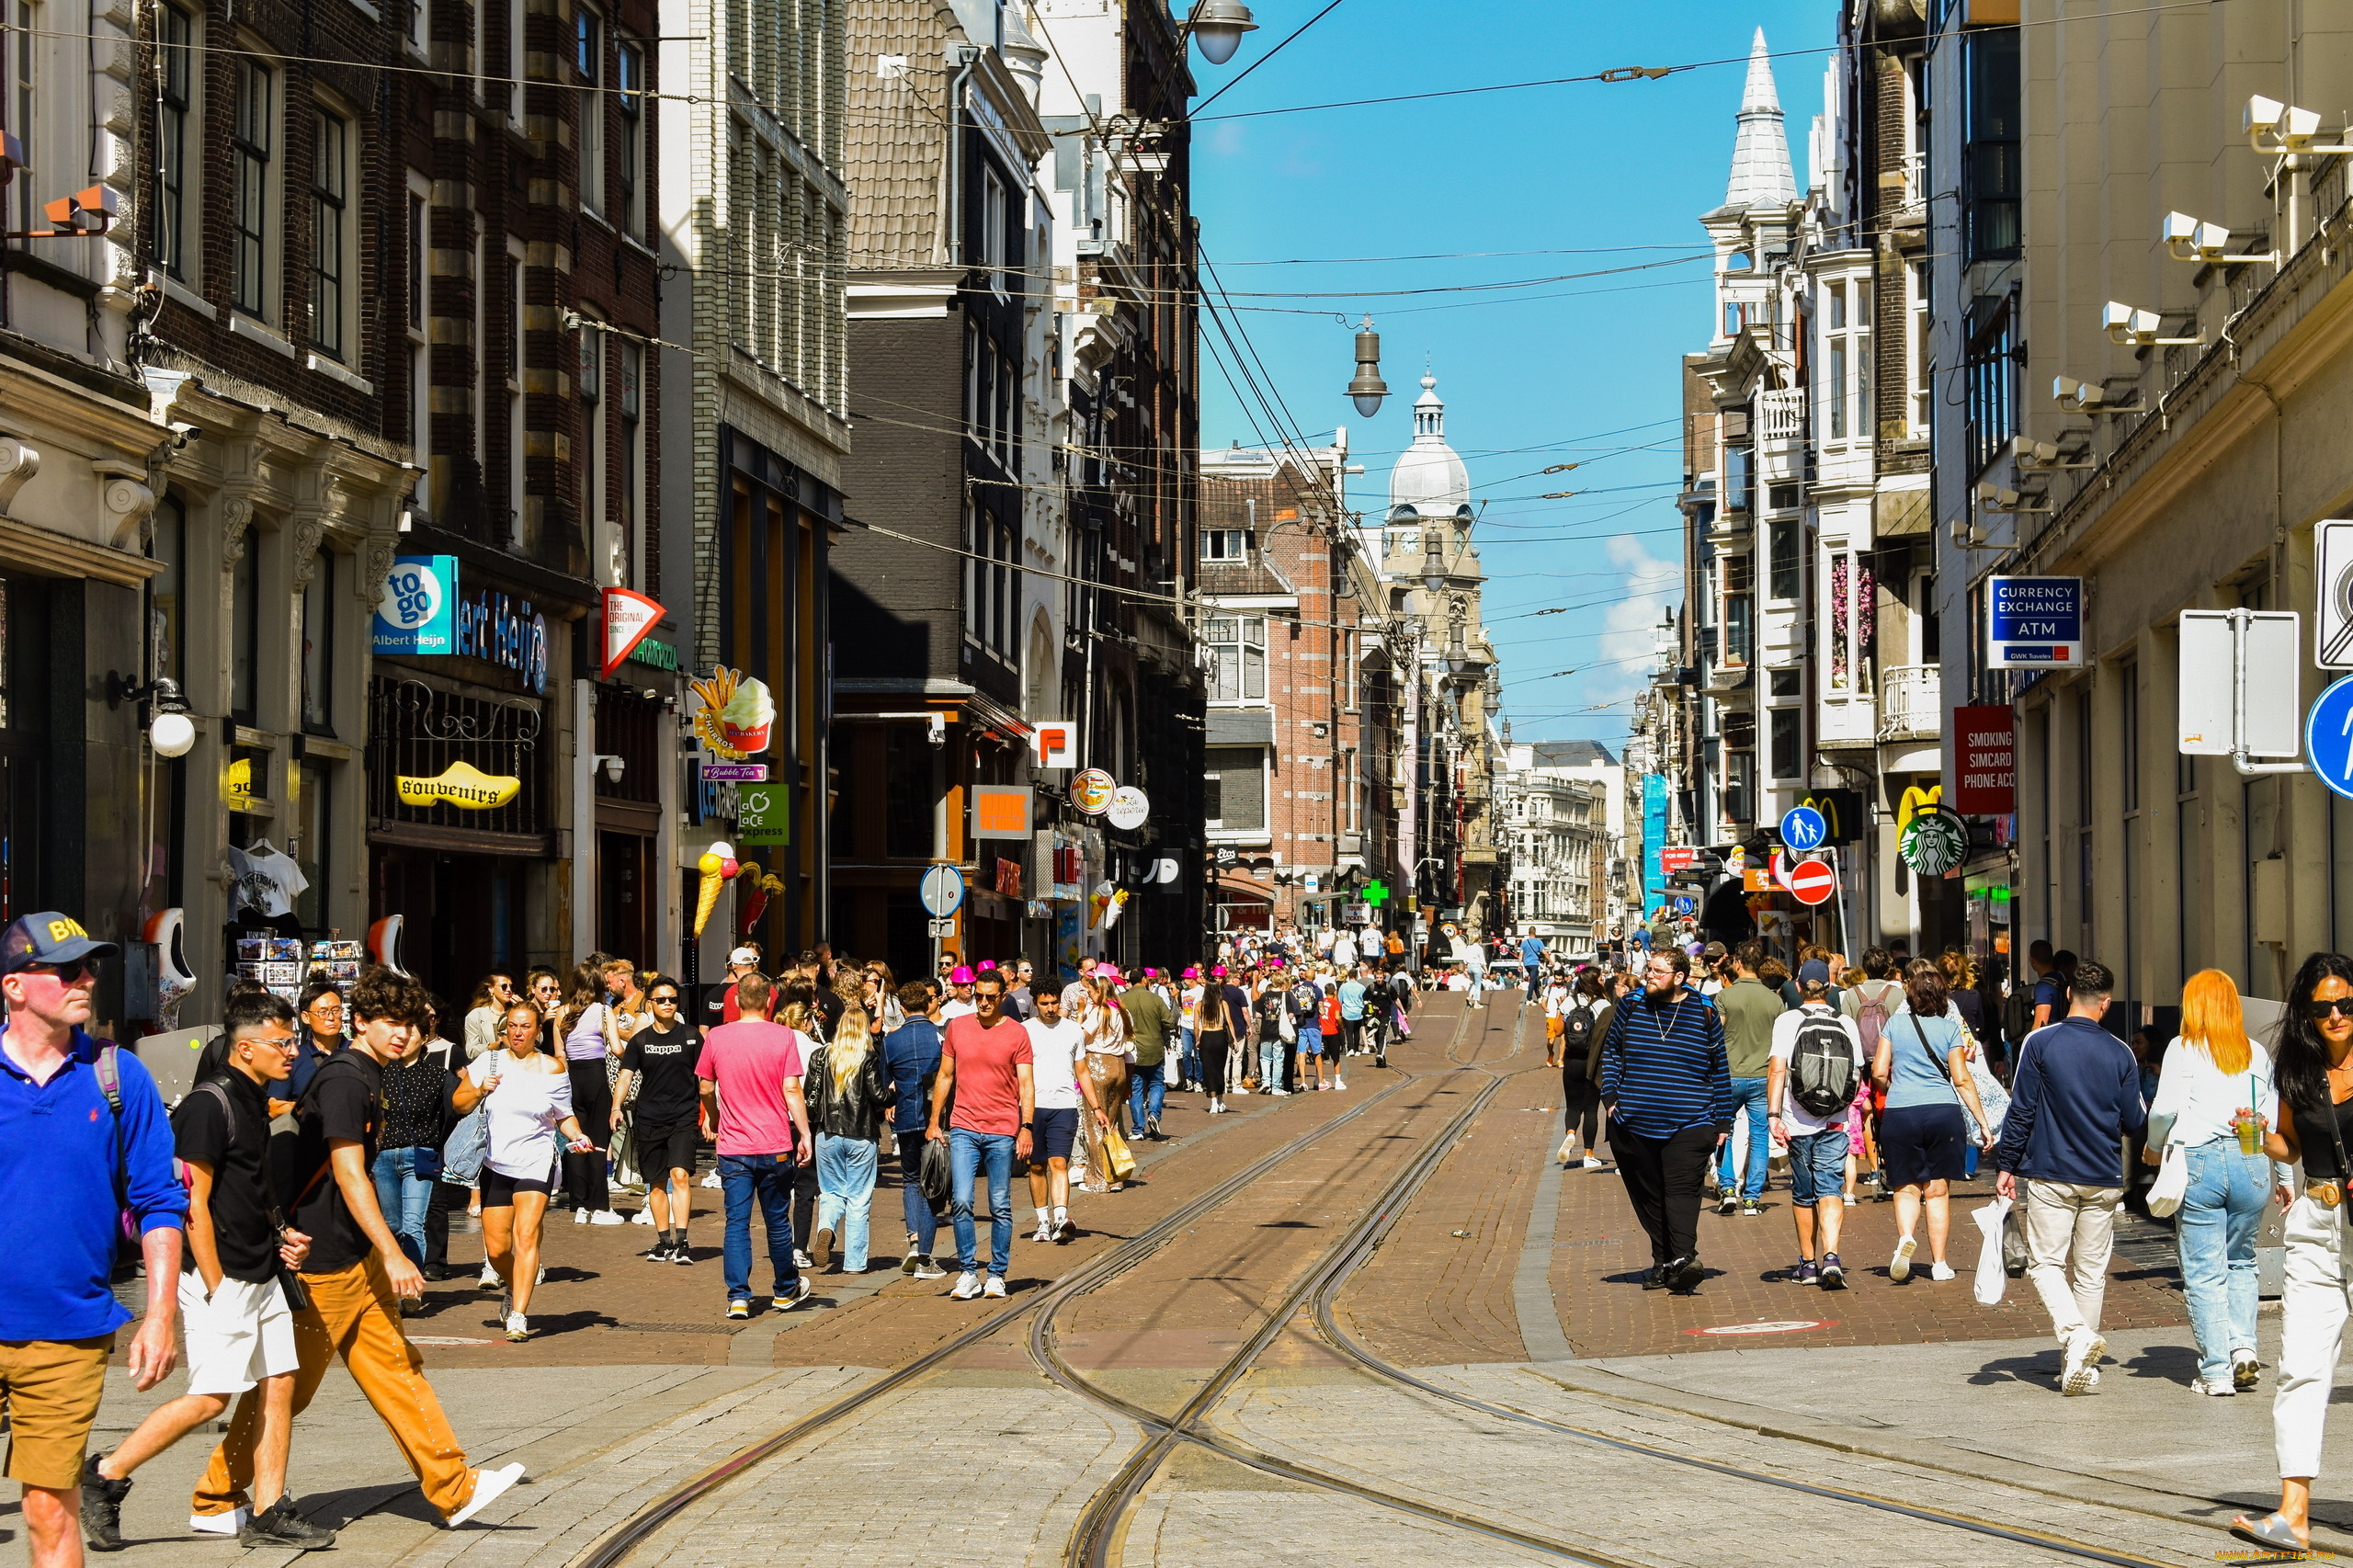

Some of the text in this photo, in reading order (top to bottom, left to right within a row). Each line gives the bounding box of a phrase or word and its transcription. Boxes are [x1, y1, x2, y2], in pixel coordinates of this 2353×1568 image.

[388, 573, 420, 597] to
[1999, 587, 2073, 597] CURRENCY
[397, 591, 431, 624] go
[608, 600, 623, 612] THE
[1999, 602, 2073, 612] EXCHANGE
[608, 612, 643, 623] ORIGINAL
[460, 589, 488, 660] ert
[608, 625, 624, 634] SINCE
[2018, 622, 2055, 635] ATM
[372, 634, 446, 648] Albert Heijn
[704, 713, 734, 749] CHURROS
[740, 729, 765, 737] BAKERY
[1968, 732, 2013, 747] SMOKING
[1969, 752, 2012, 767] SIMCARD
[710, 767, 756, 778] Bubble Tea
[1964, 773, 1996, 788] PHONE
[401, 780, 501, 805] souvenirs
[1217, 847, 1236, 859] Etos
[644, 1044, 682, 1054] Kappa
